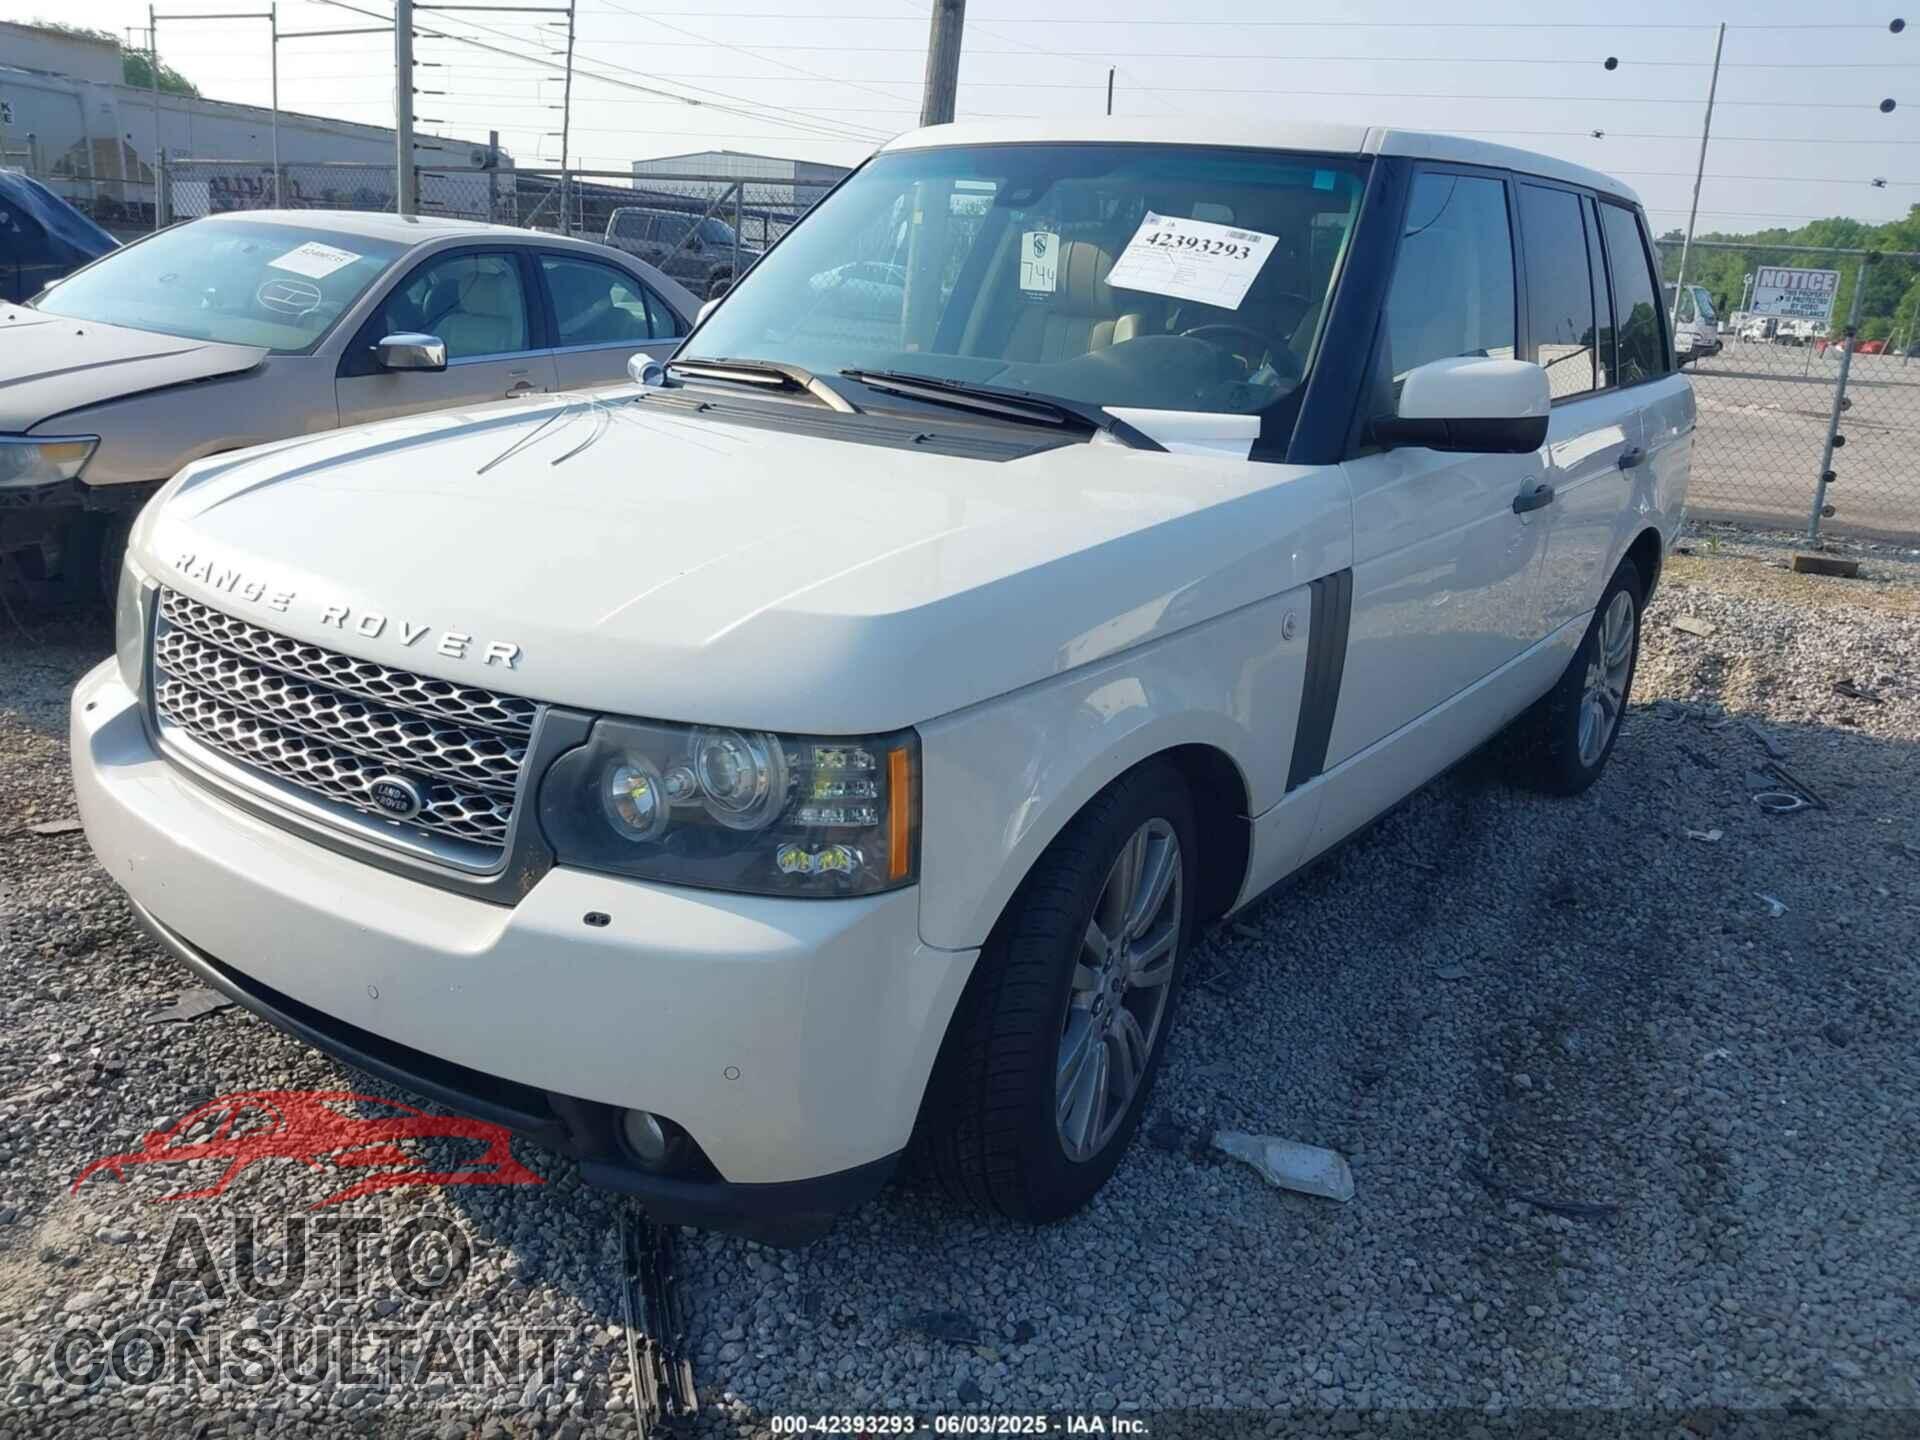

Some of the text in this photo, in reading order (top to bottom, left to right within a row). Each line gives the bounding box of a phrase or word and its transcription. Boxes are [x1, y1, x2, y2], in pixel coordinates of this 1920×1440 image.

[1146, 231, 1251, 260] 42393293
[1022, 261, 1056, 292] 744
[1760, 270, 1835, 290] NOTICE
[175, 553, 523, 670] RANGE ROVER
[378, 784, 401, 799] LAND
[379, 796, 408, 811] ROVER
